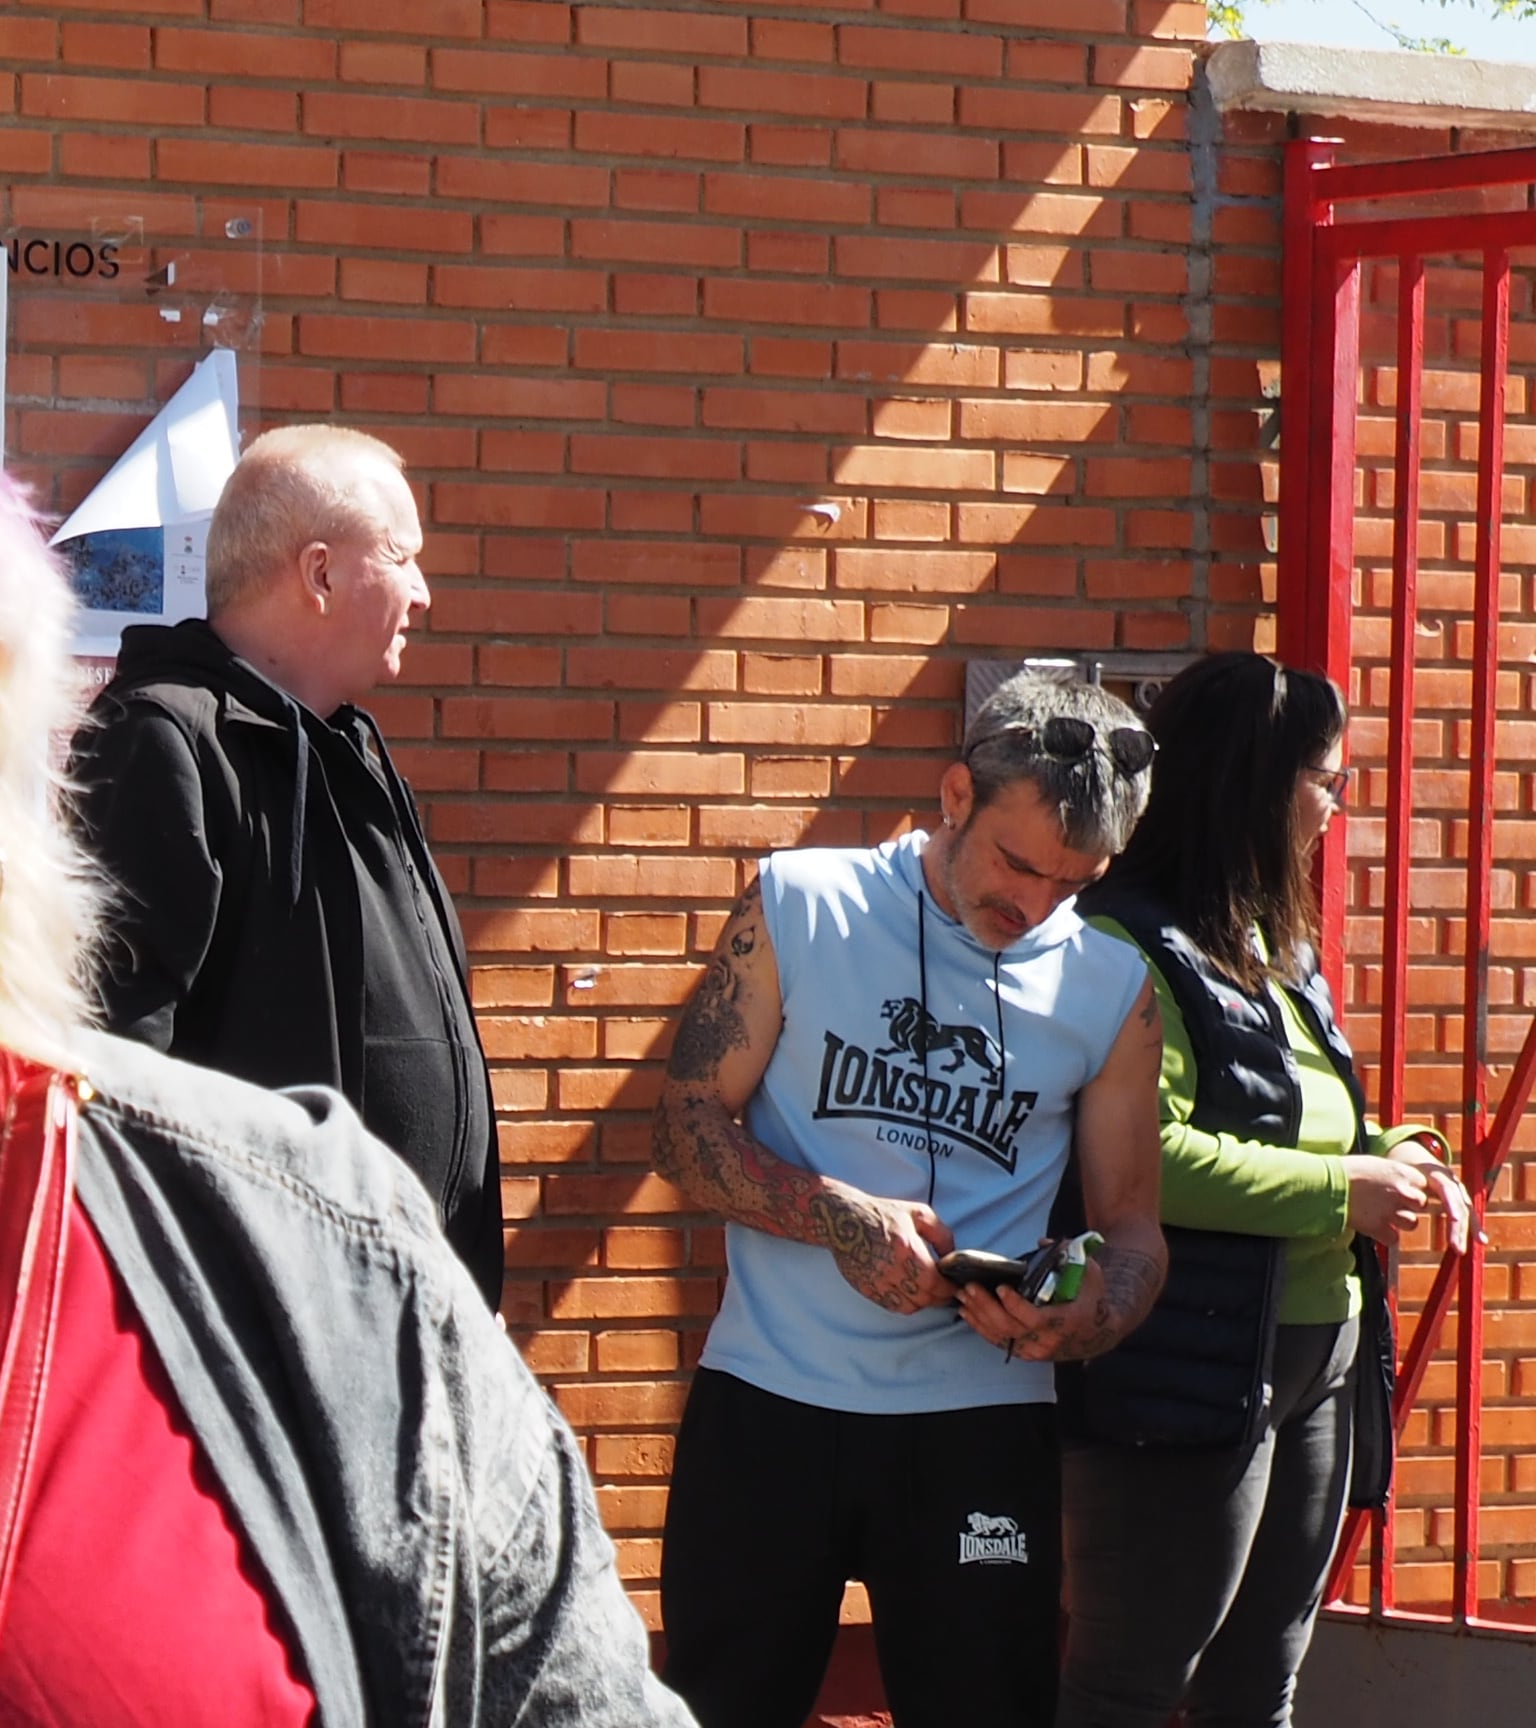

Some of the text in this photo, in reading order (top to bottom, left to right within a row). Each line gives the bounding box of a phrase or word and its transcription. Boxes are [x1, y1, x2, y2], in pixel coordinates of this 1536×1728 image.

[812, 1030, 1039, 1176] LONSDALE
[876, 1125, 954, 1159] LONDON
[958, 1532, 1029, 1565] LONSDALE
